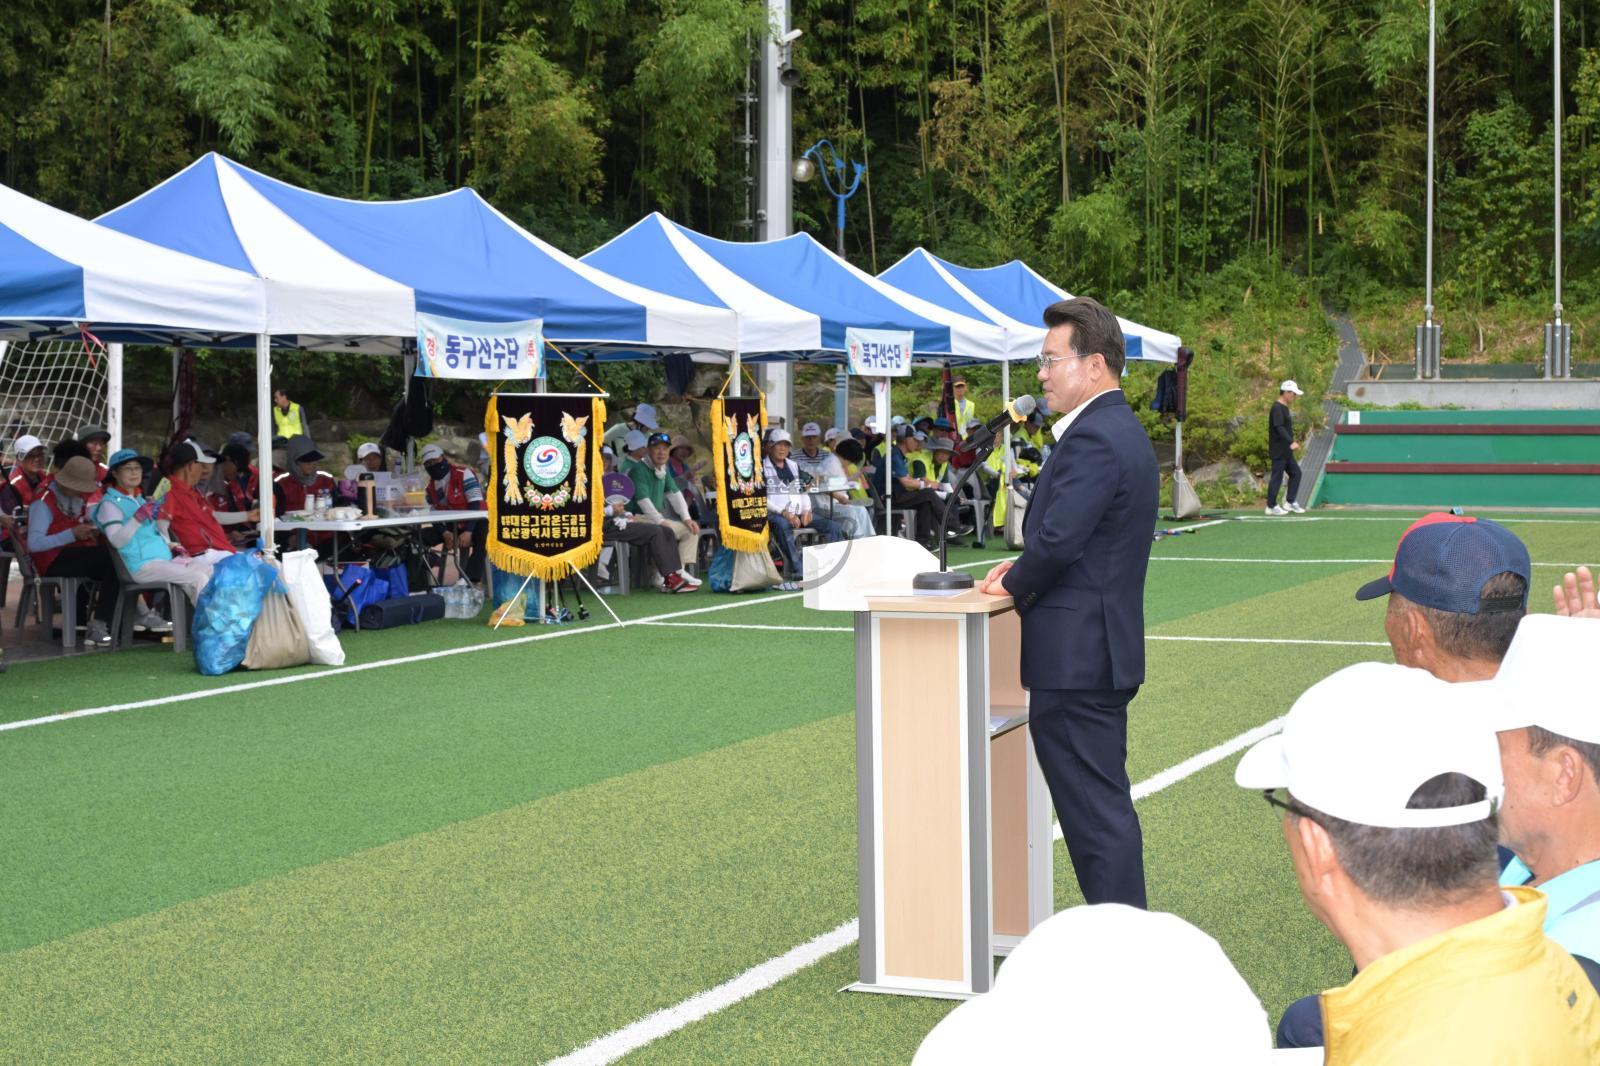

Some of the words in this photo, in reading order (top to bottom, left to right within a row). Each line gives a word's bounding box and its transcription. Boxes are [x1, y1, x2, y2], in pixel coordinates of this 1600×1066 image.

[445, 334, 520, 370] 동구선수단
[862, 342, 901, 368] 북구선수단
[502, 526, 587, 540] 울산광역시동구협회
